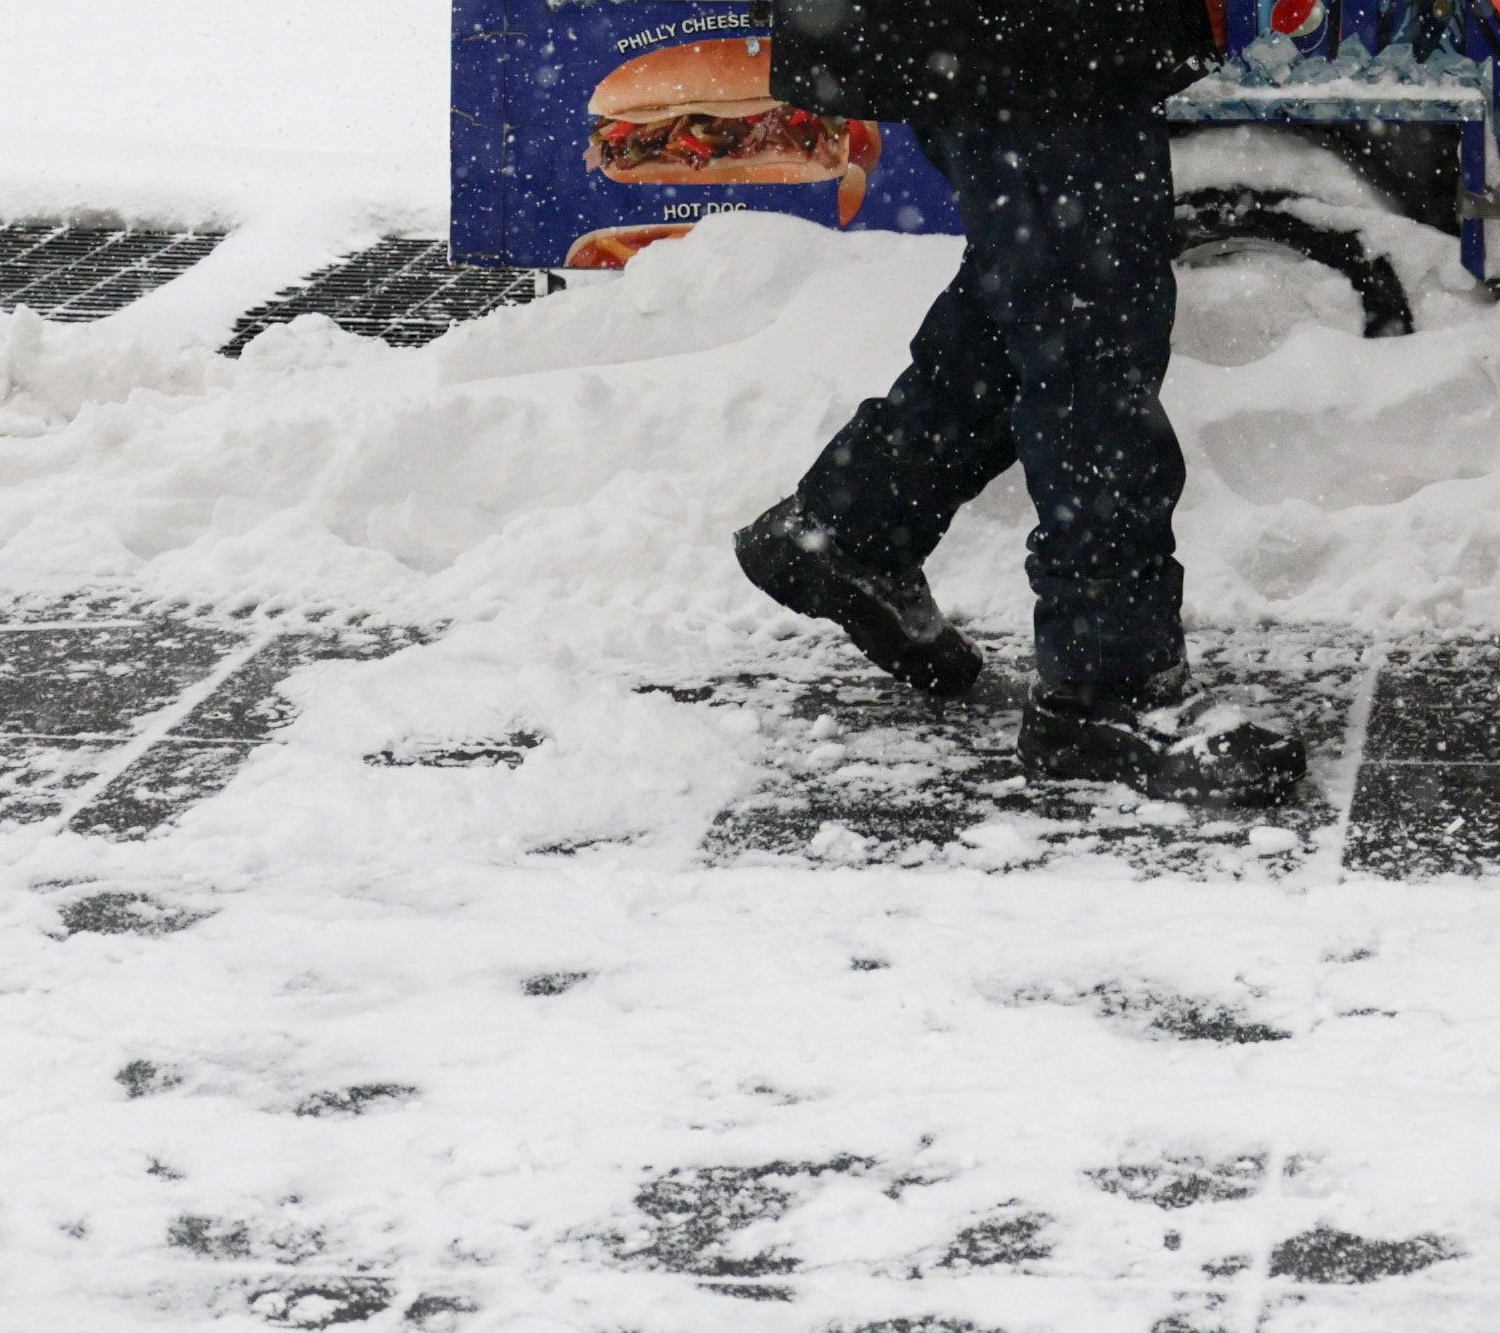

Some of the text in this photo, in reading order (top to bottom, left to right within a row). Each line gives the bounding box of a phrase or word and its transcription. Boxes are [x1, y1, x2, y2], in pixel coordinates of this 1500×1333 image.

[616, 22, 678, 55] PHILLY
[681, 14, 751, 35] CHEESE
[663, 202, 702, 221] HOT
